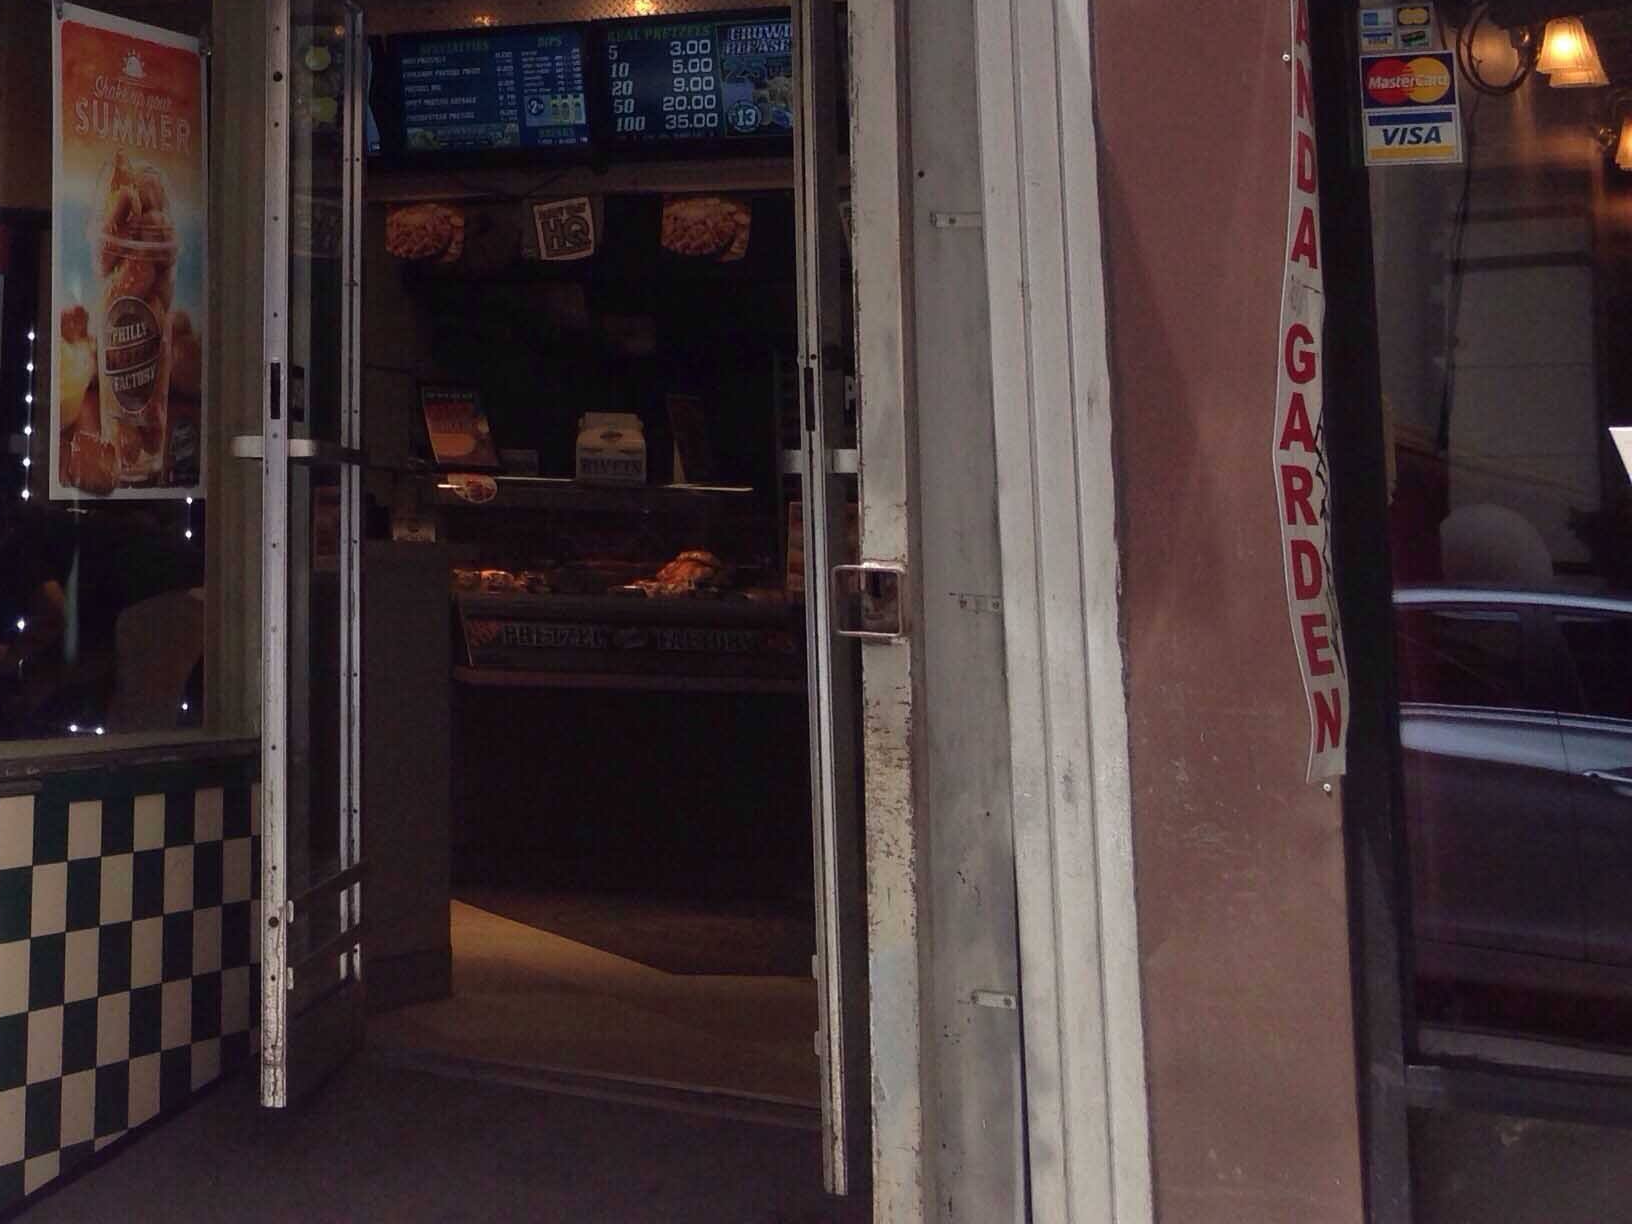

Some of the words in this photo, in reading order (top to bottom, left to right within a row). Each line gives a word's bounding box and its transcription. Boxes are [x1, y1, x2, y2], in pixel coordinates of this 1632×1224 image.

[608, 45, 618, 60] 5
[669, 40, 711, 56] 3.00
[611, 62, 630, 78] 10
[672, 58, 713, 74] 5.00
[611, 80, 633, 96] 20
[672, 76, 715, 92] 9.00
[1369, 75, 1449, 90] MasterCard
[613, 98, 635, 114] 50
[662, 94, 717, 111] 20.00
[74, 96, 193, 154] SUMMER
[616, 116, 646, 132] 100
[664, 113, 718, 129] 35.00
[1382, 126, 1442, 146] VISA
[111, 321, 148, 344] PHILLY
[113, 364, 158, 393] FACTORY
[1279, 323, 1341, 753] GARDEN
